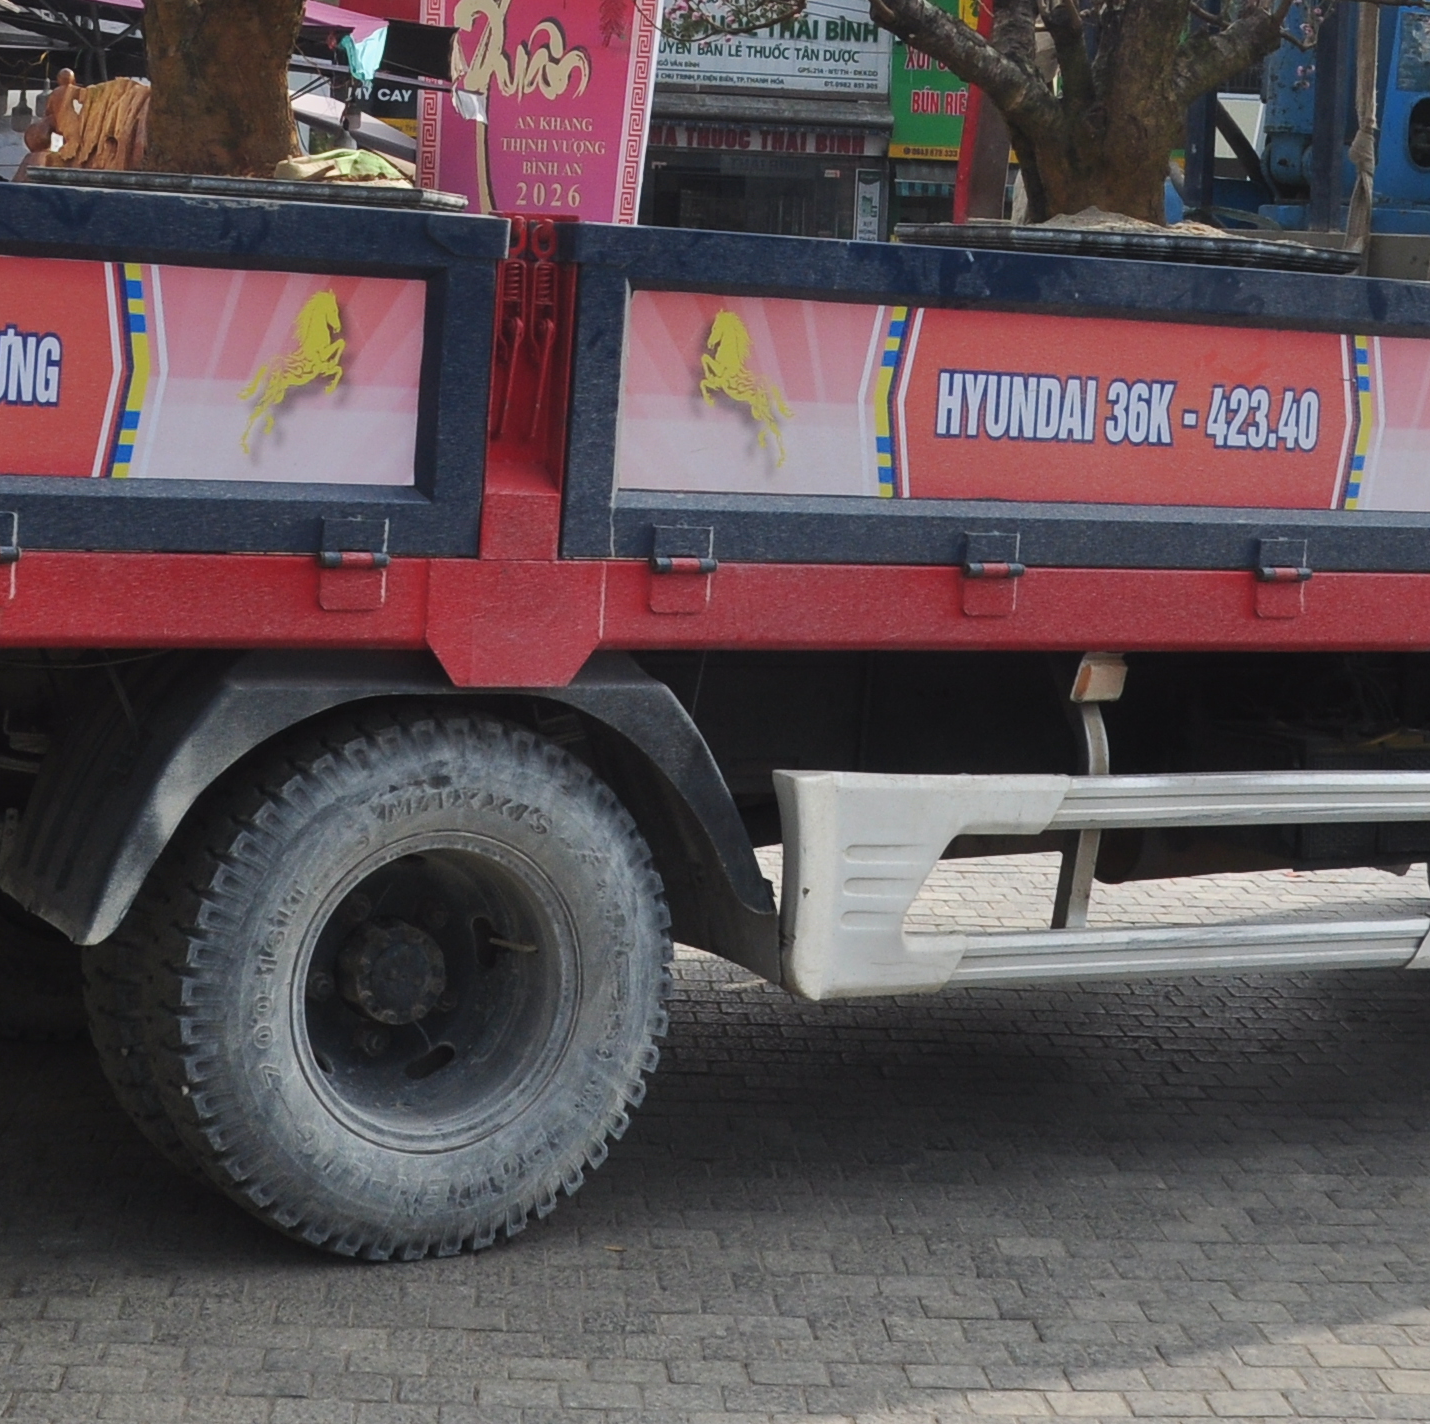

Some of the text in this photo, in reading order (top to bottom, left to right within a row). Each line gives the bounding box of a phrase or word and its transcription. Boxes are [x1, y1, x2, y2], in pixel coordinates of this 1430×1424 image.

[825, 16, 879, 43] BÌNH
[727, 40, 743, 58] LẺ
[746, 43, 790, 60] THUỐC
[794, 46, 821, 62] TÂN
[823, 50, 860, 66] DƯỢC
[377, 88, 412, 103] CAY
[911, 86, 969, 116] BÚN RIÊ
[515, 115, 593, 132] AN KHANG
[501, 138, 606, 157] THỊNH VƯỢNG
[523, 157, 582, 176] BÌNH AN
[516, 182, 581, 207] 2026
[935, 371, 1097, 442] HYUNDAI
[1105, 380, 1175, 445] 36K
[1206, 385, 1320, 451] 423.40
